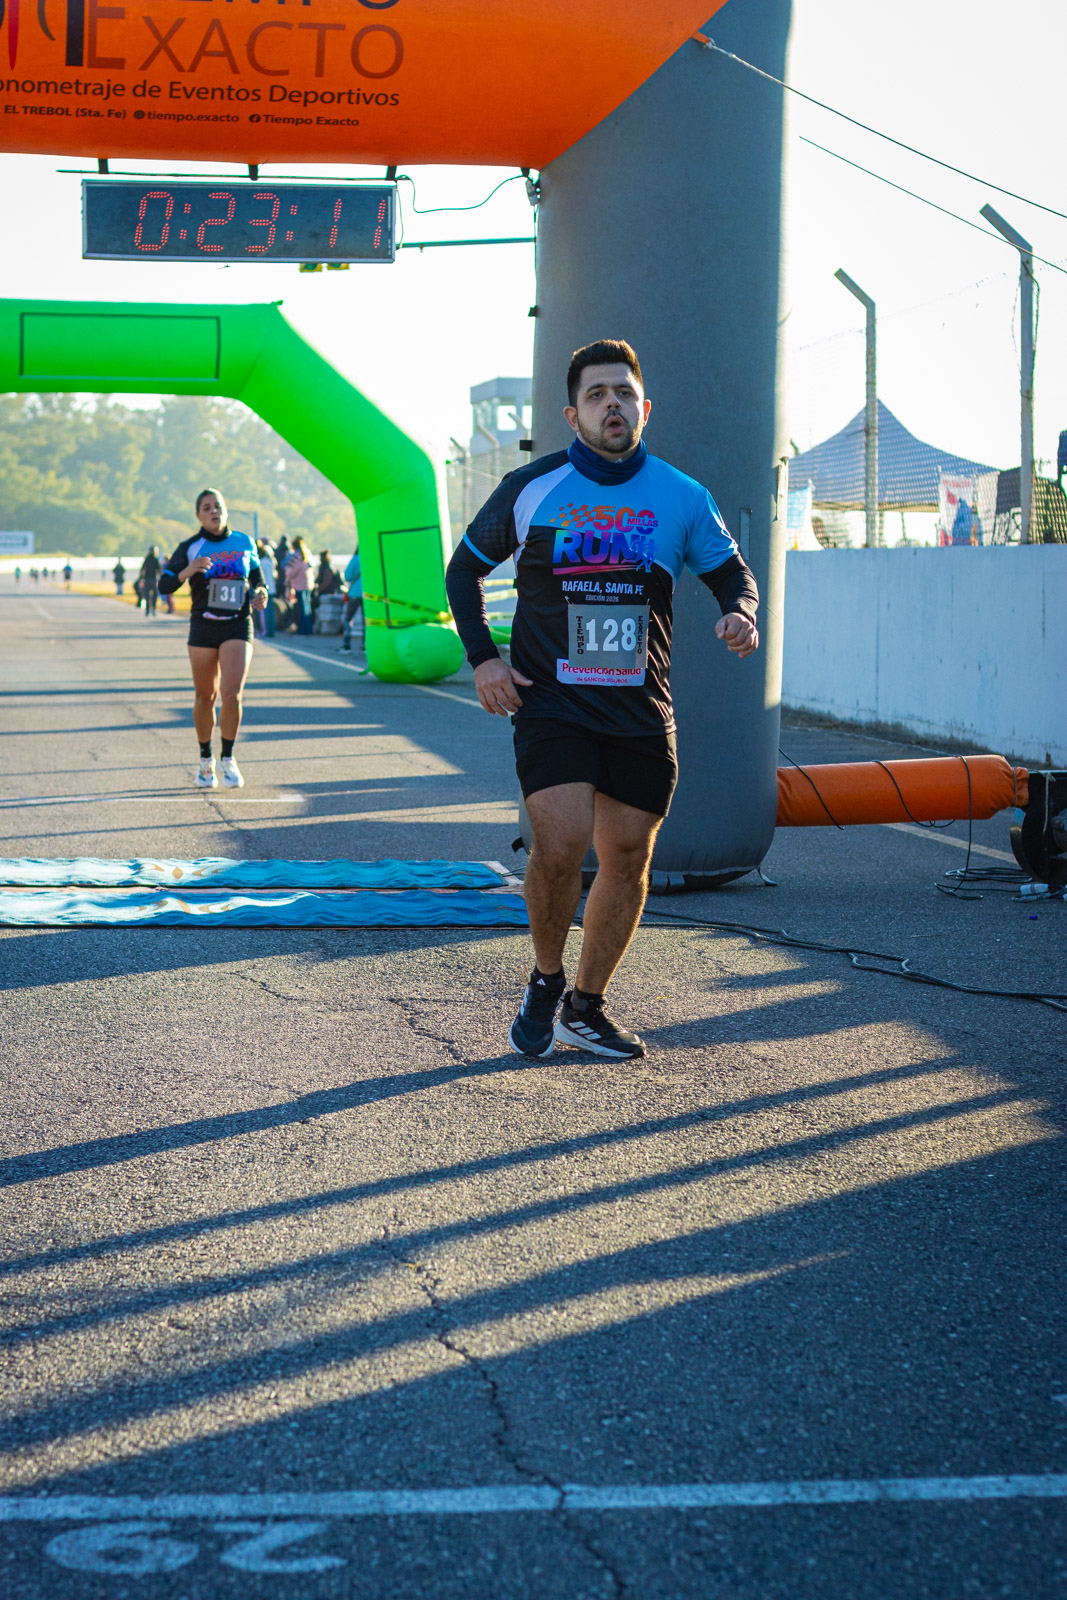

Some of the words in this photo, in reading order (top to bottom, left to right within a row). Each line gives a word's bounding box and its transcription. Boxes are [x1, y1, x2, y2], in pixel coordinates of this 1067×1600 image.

[132, 79, 161, 98] de
[169, 81, 261, 101] Eventos
[269, 84, 400, 107] Deportivos
[4, 104, 19, 114] EL
[22, 105, 73, 116] TREBOL
[75, 107, 105, 118] (Sta.
[107, 109, 127, 119] Fe)
[147, 110, 240, 123] tiempo.exacto
[263, 114, 313, 126] Tiempo
[316, 116, 360, 126] Exacto
[593, 506, 656, 535] 500
[627, 517, 659, 528] MILLAS
[552, 529, 646, 565] RUN
[220, 585, 236, 602] 31
[562, 580, 602, 594] RAFAELA,
[605, 582, 633, 594] SANTA
[576, 616, 585, 655] TIEMPO
[585, 617, 637, 652] 128
